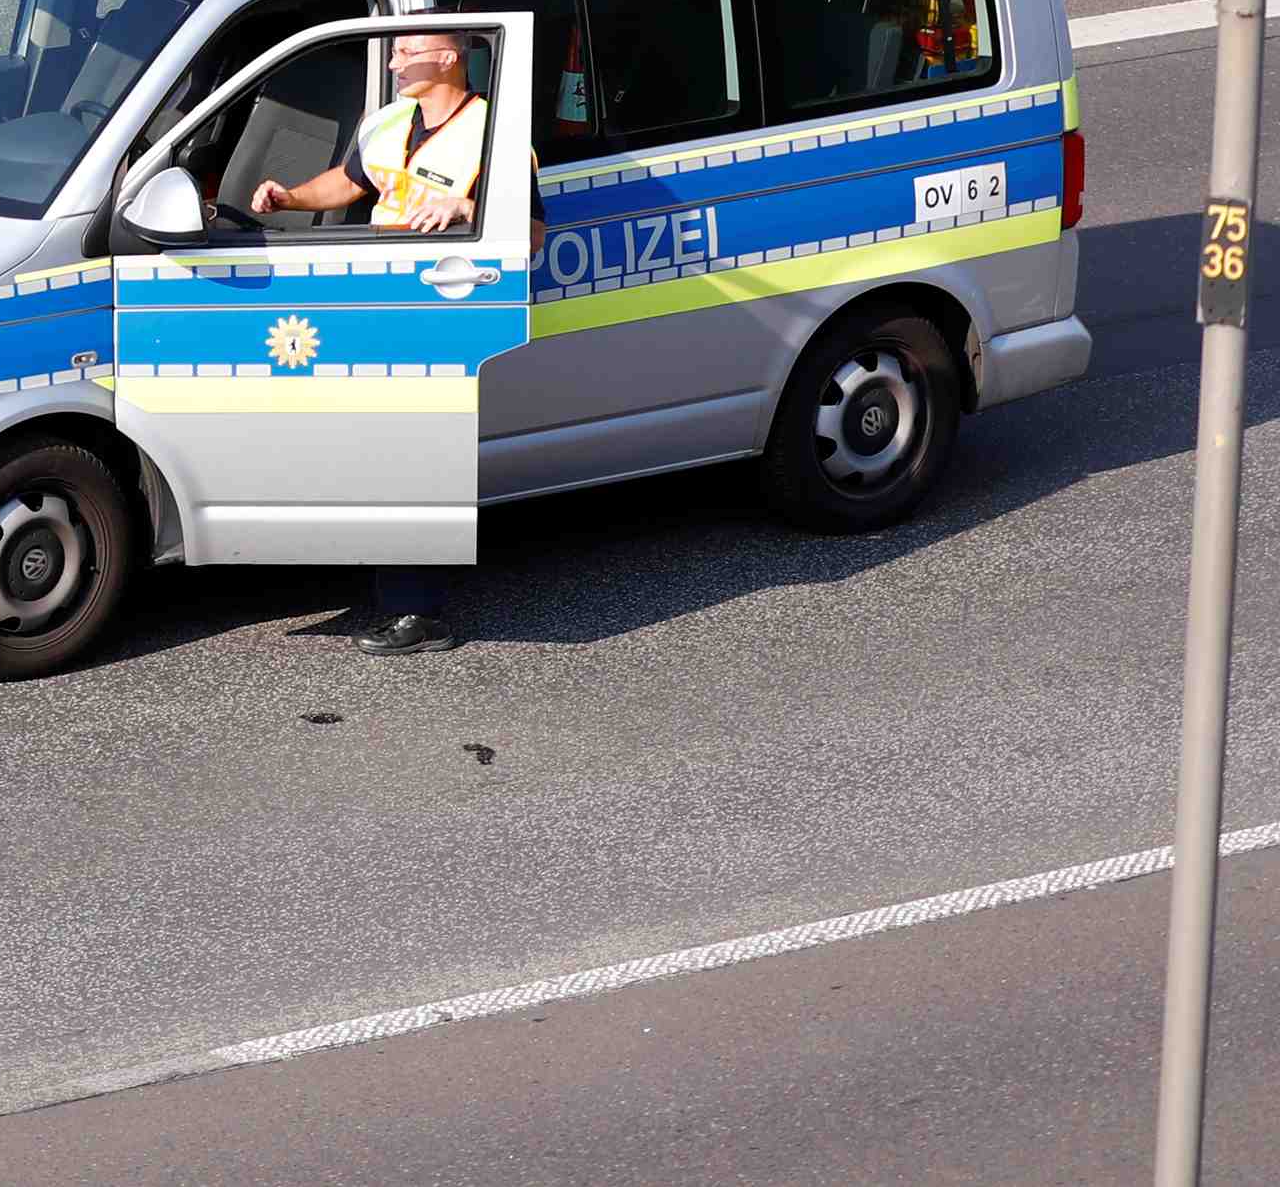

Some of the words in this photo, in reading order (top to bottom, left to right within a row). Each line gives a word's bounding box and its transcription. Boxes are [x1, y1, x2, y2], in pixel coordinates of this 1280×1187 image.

[924, 184, 953, 208] OV
[1208, 204, 1246, 242] 75
[1203, 243, 1244, 280] 36
